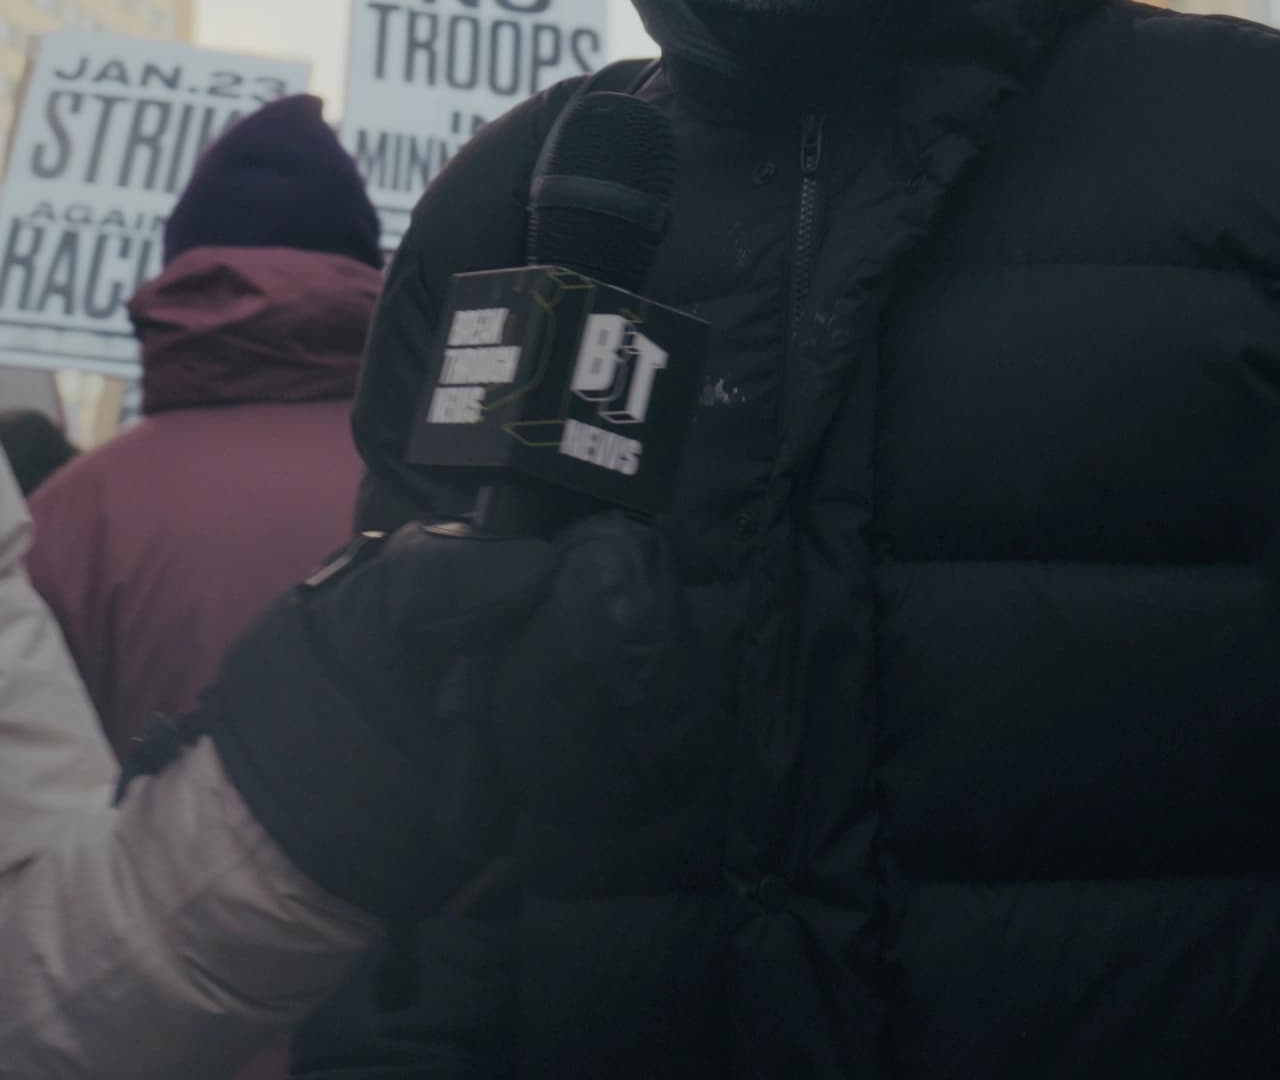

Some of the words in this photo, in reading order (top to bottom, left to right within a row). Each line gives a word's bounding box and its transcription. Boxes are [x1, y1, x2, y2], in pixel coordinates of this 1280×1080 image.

[53, 57, 289, 104] JAN.23
[368, 1, 600, 96] TROOPS
[30, 88, 246, 194] STRI
[558, 418, 643, 476] NEWS
